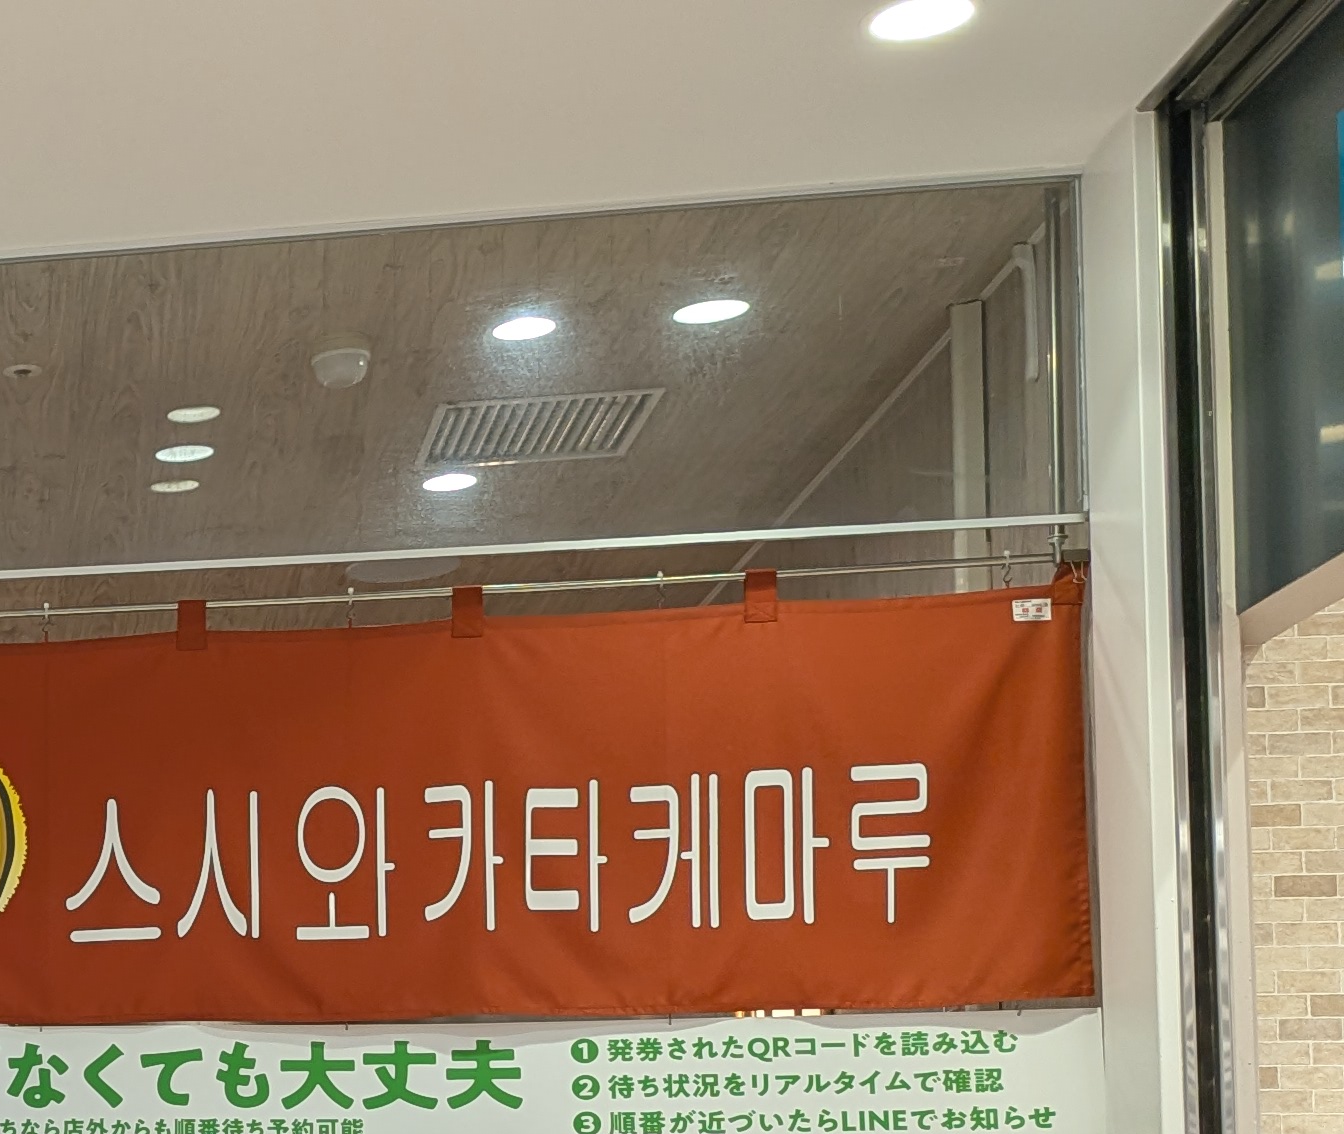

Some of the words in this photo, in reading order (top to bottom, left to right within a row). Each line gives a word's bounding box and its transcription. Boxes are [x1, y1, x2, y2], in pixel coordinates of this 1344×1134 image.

[65, 762, 930, 941] 스시와카타케마루
[607, 1029, 1019, 1063] 発券されたQRコードを読み込む
[608, 1067, 1004, 1100] 待ち状況をリアルタイムで確認
